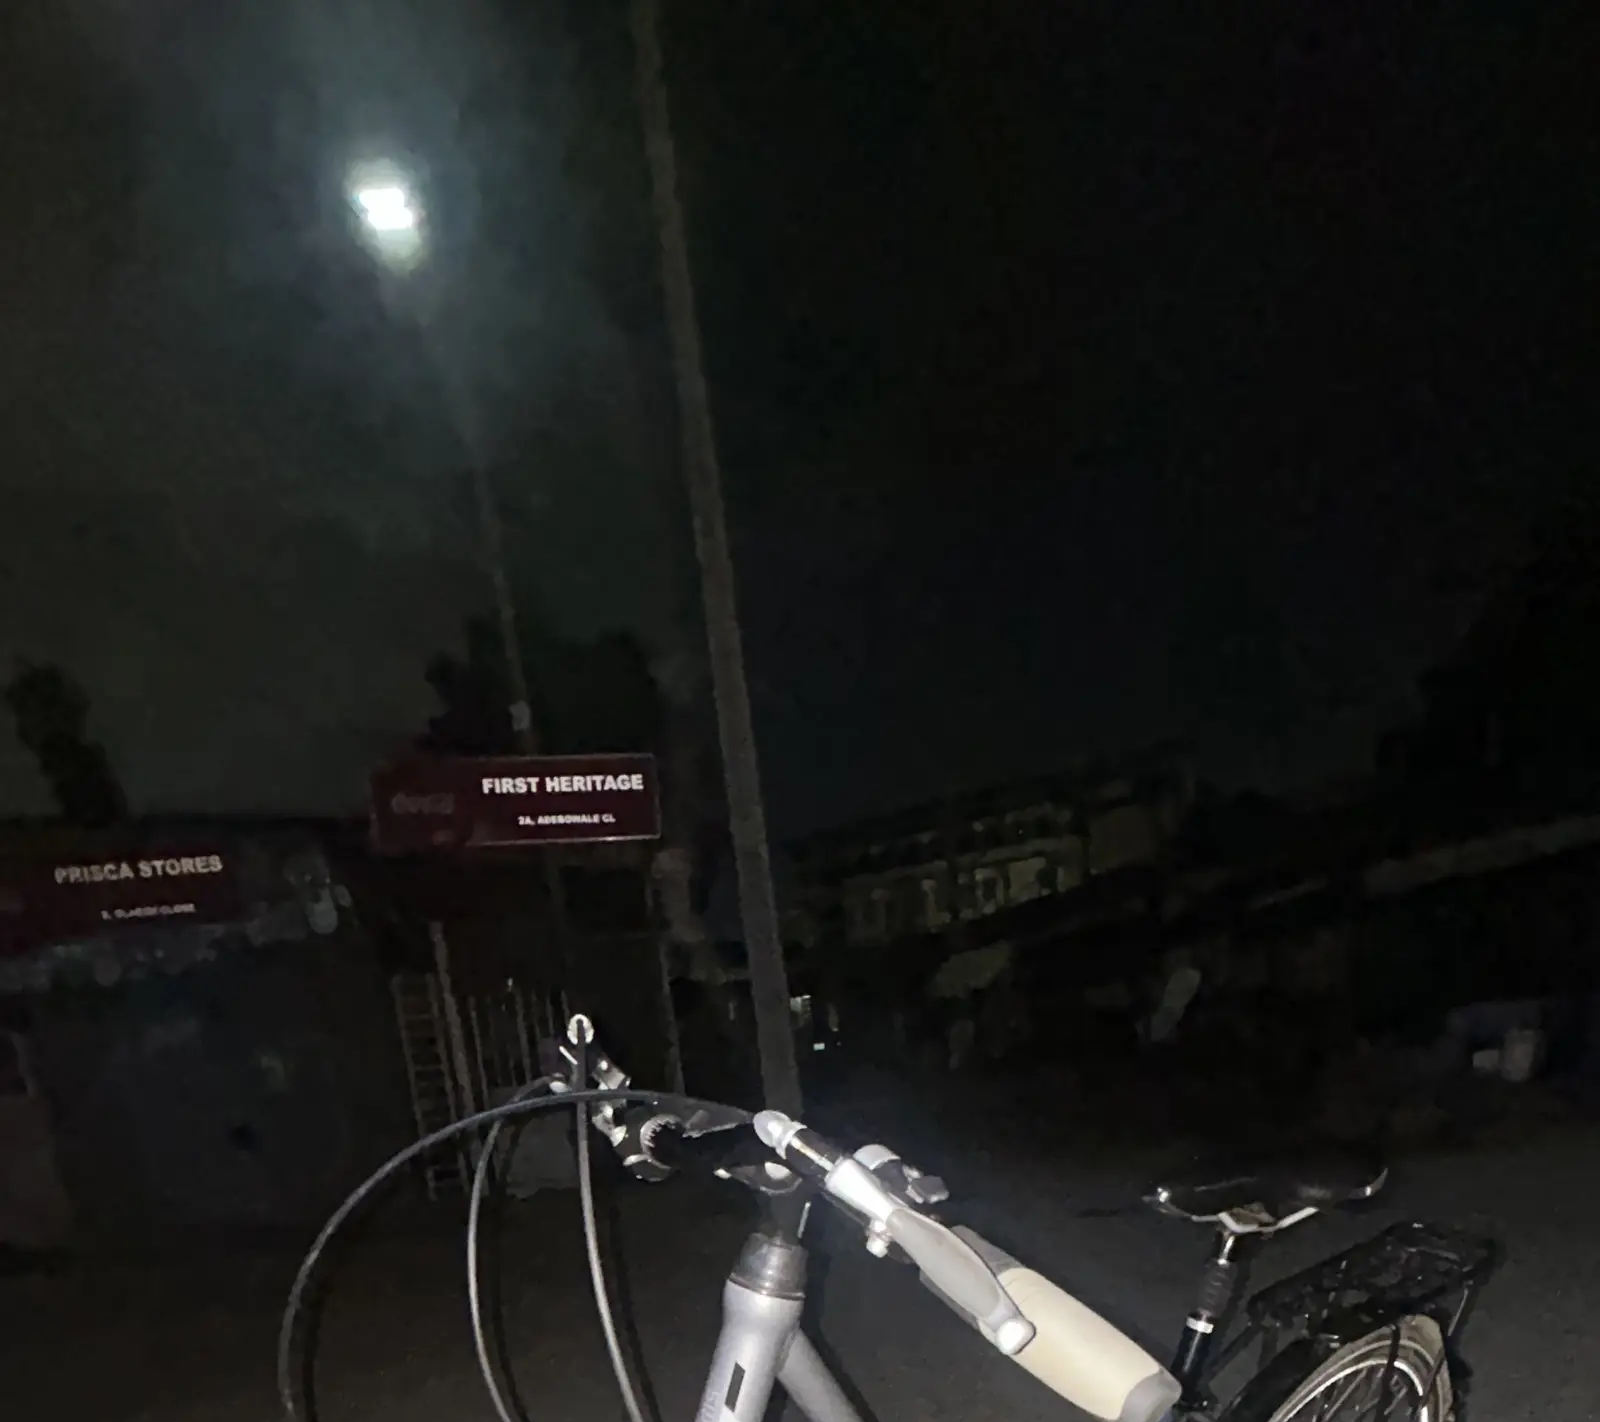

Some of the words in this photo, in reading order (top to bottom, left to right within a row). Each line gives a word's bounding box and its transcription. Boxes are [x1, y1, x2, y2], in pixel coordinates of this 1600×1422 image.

[482, 776, 540, 794] FIRST
[545, 774, 644, 792] HERITAGE
[54, 861, 135, 884] PRISCA
[138, 854, 223, 877] STORES
